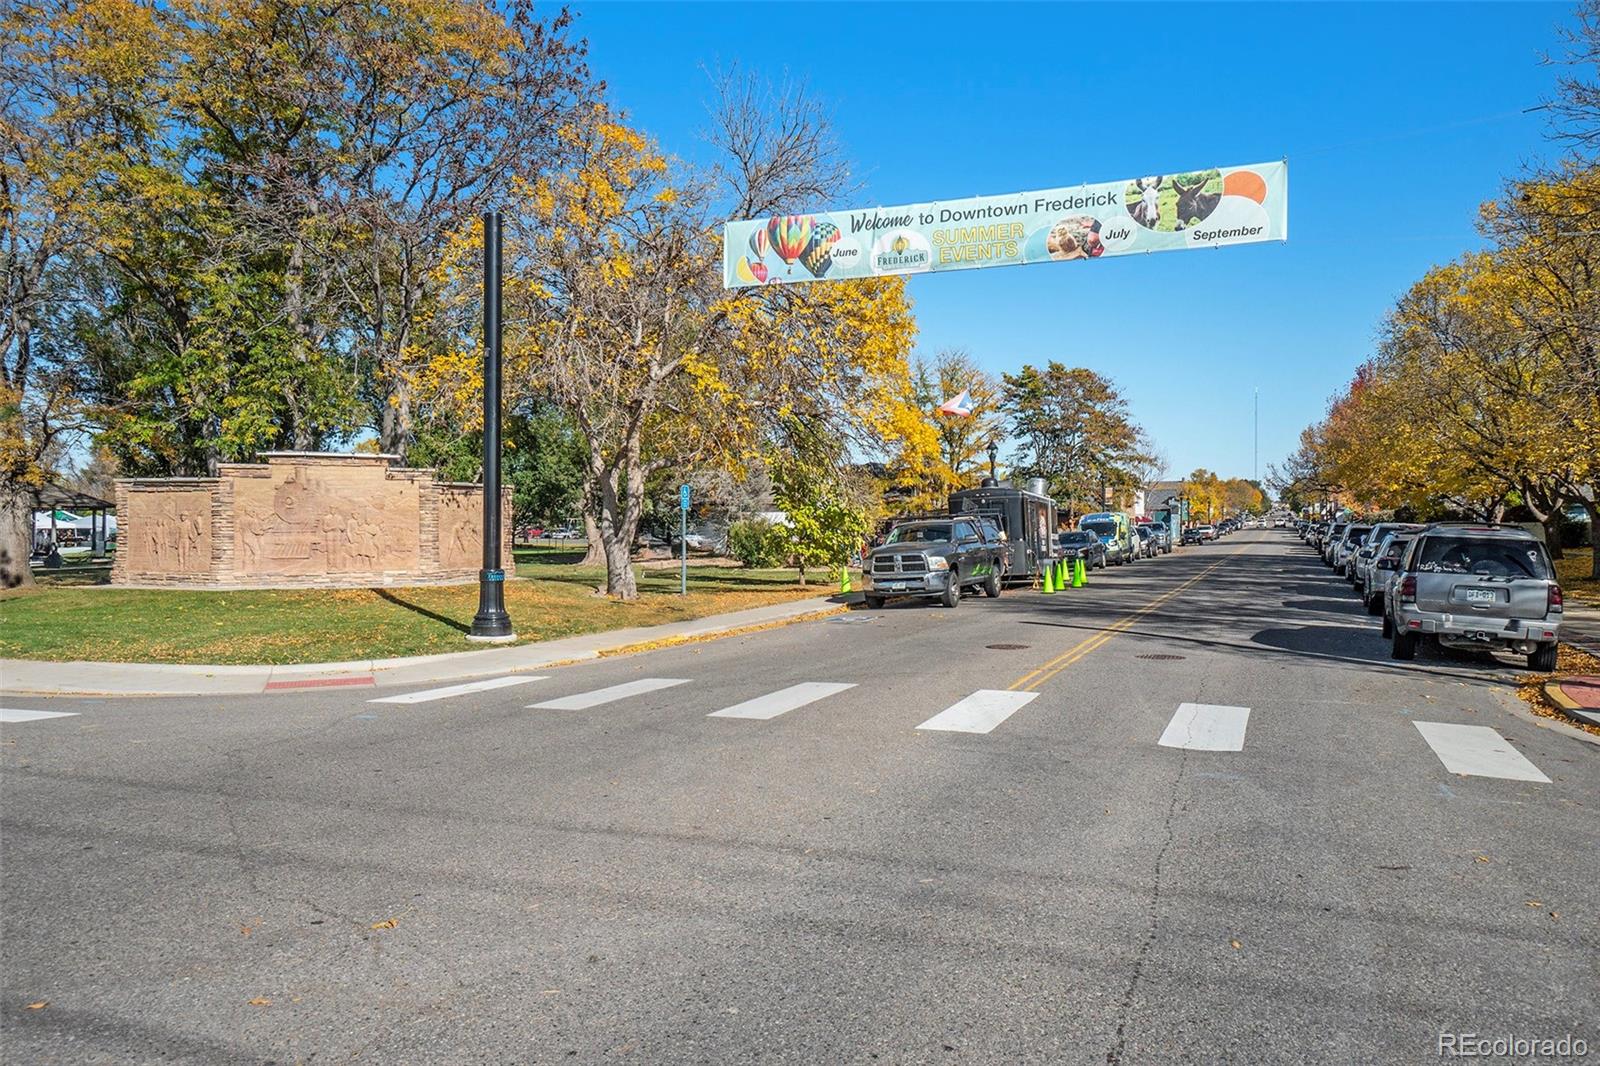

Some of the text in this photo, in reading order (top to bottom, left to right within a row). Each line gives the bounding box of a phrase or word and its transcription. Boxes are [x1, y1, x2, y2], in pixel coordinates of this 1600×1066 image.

[851, 191, 1117, 233] Welcome to Downtown Frederick
[932, 222, 1024, 246] SUMMER
[1105, 228, 1130, 241] July
[1193, 225, 1263, 242] September
[833, 247, 857, 258] June
[877, 252, 925, 266] FREDERICK
[939, 241, 1018, 264] EVENTS
